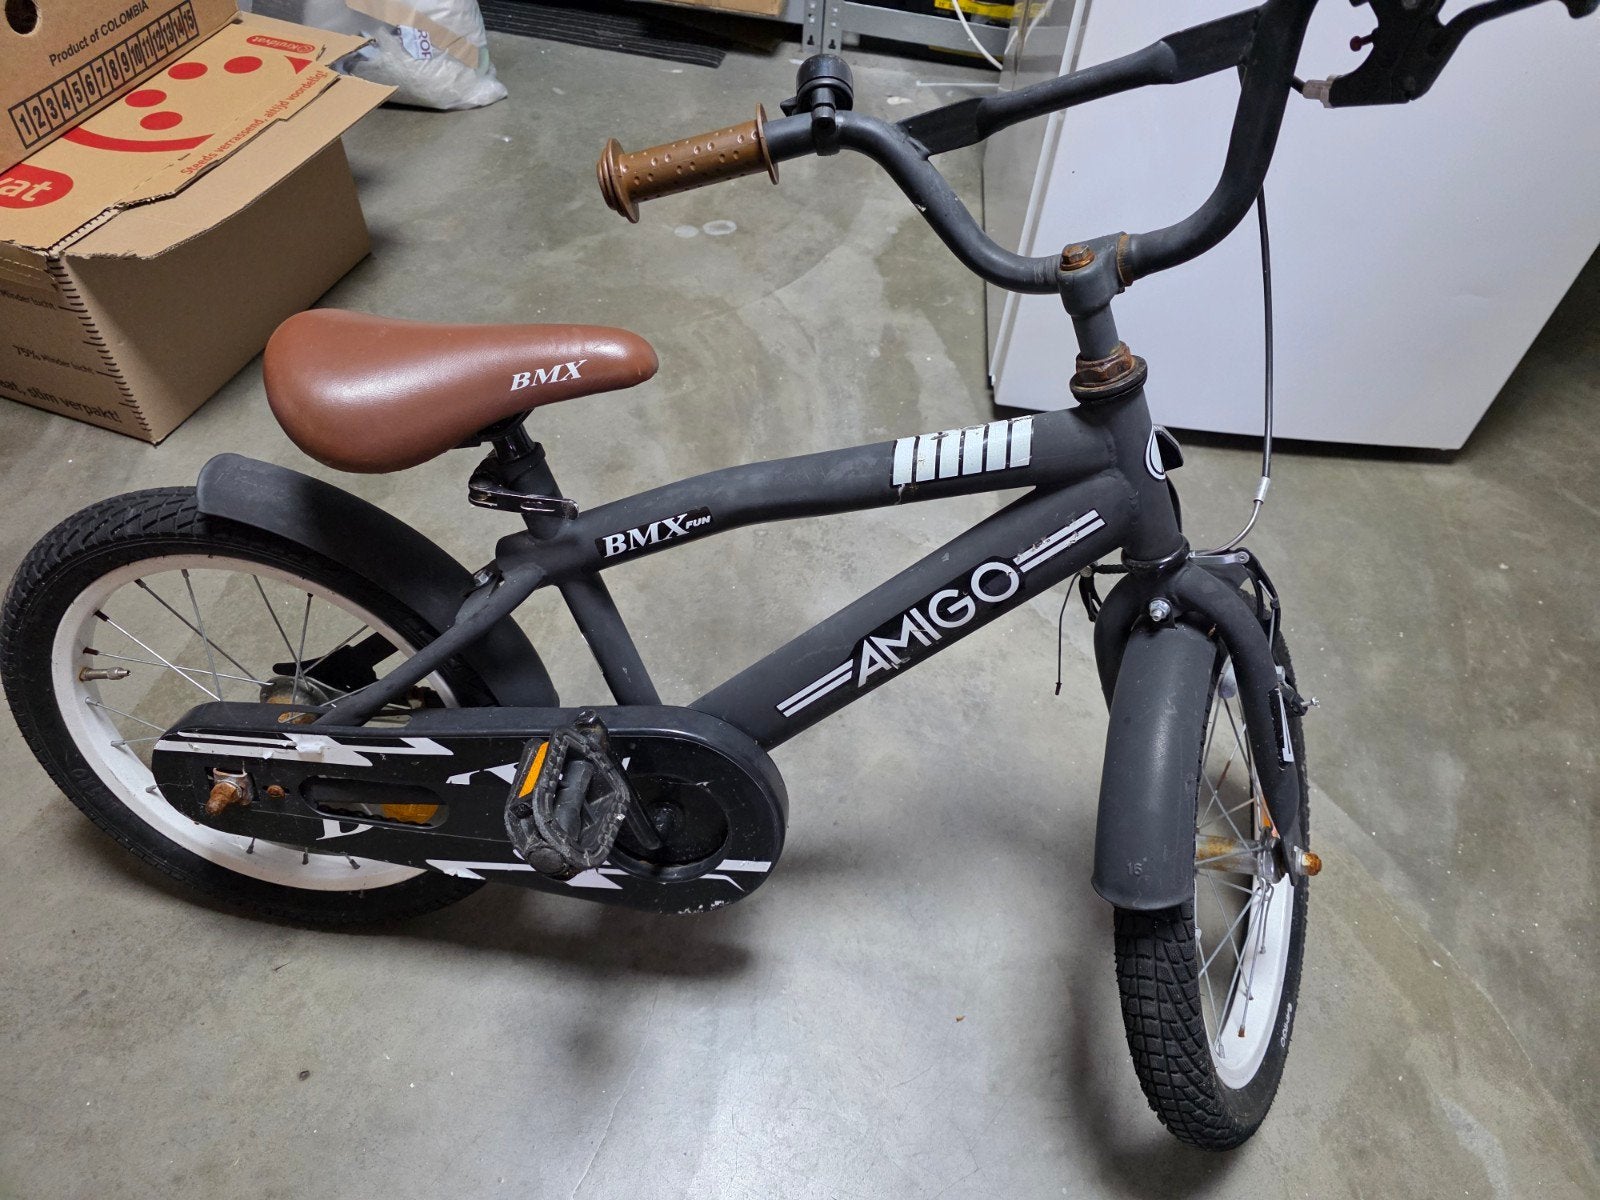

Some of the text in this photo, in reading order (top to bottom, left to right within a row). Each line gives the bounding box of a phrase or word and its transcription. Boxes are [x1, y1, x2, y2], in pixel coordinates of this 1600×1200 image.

[19, 10, 195, 135] 1 2 3 4 5 6 7 8 9 10 11 12 13 14 15
[49, 0, 149, 67] Product of COLOMBIA
[180, 71, 328, 175] Steeds verrassend, altijd voordelig!
[510, 359, 588, 392] BMX
[602, 513, 711, 558] BMX FUN
[858, 561, 1020, 688] AMIGO
